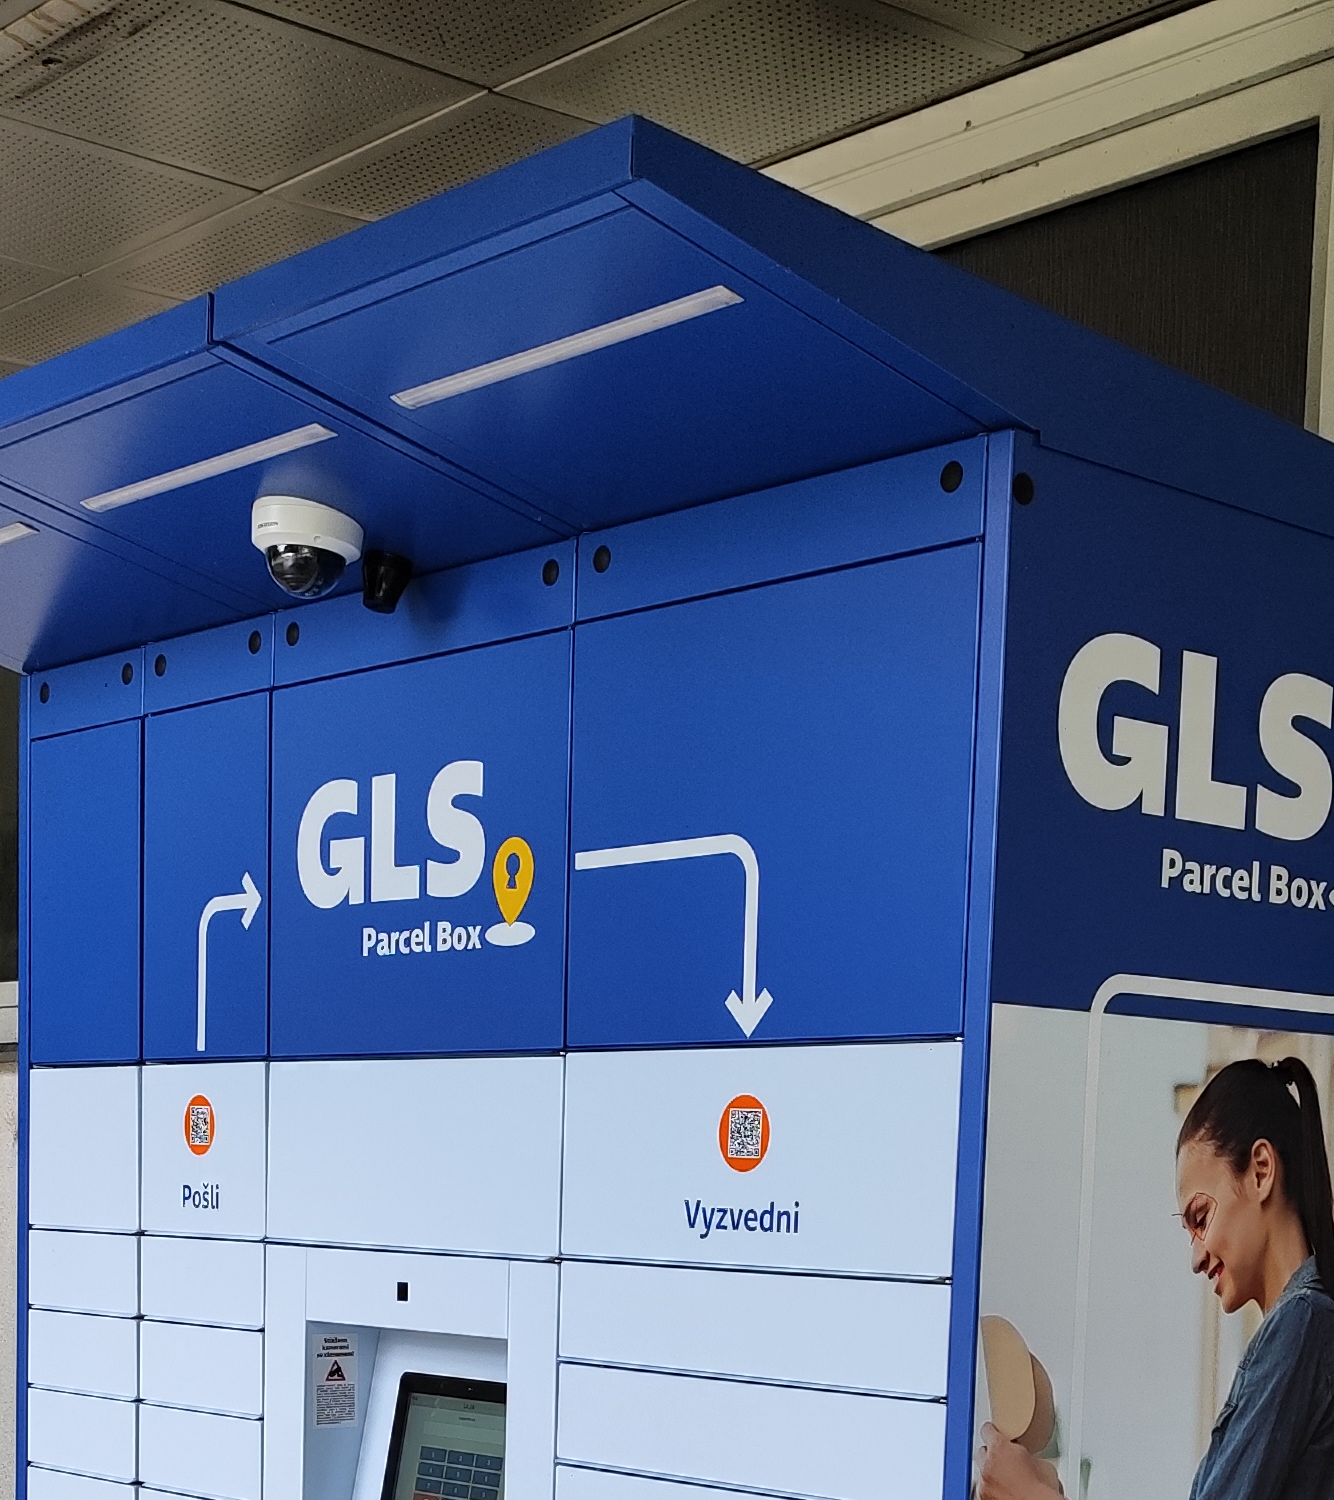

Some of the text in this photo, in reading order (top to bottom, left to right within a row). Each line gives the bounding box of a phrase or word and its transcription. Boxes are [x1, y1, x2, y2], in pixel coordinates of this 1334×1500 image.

[1057, 631, 1334, 842] GLS
[296, 760, 487, 910] GLS
[1160, 847, 1328, 911] Parcel Box
[361, 919, 482, 957] Parcel Box
[182, 1182, 220, 1210] Pošli
[683, 1199, 801, 1240] Vyzvedni
